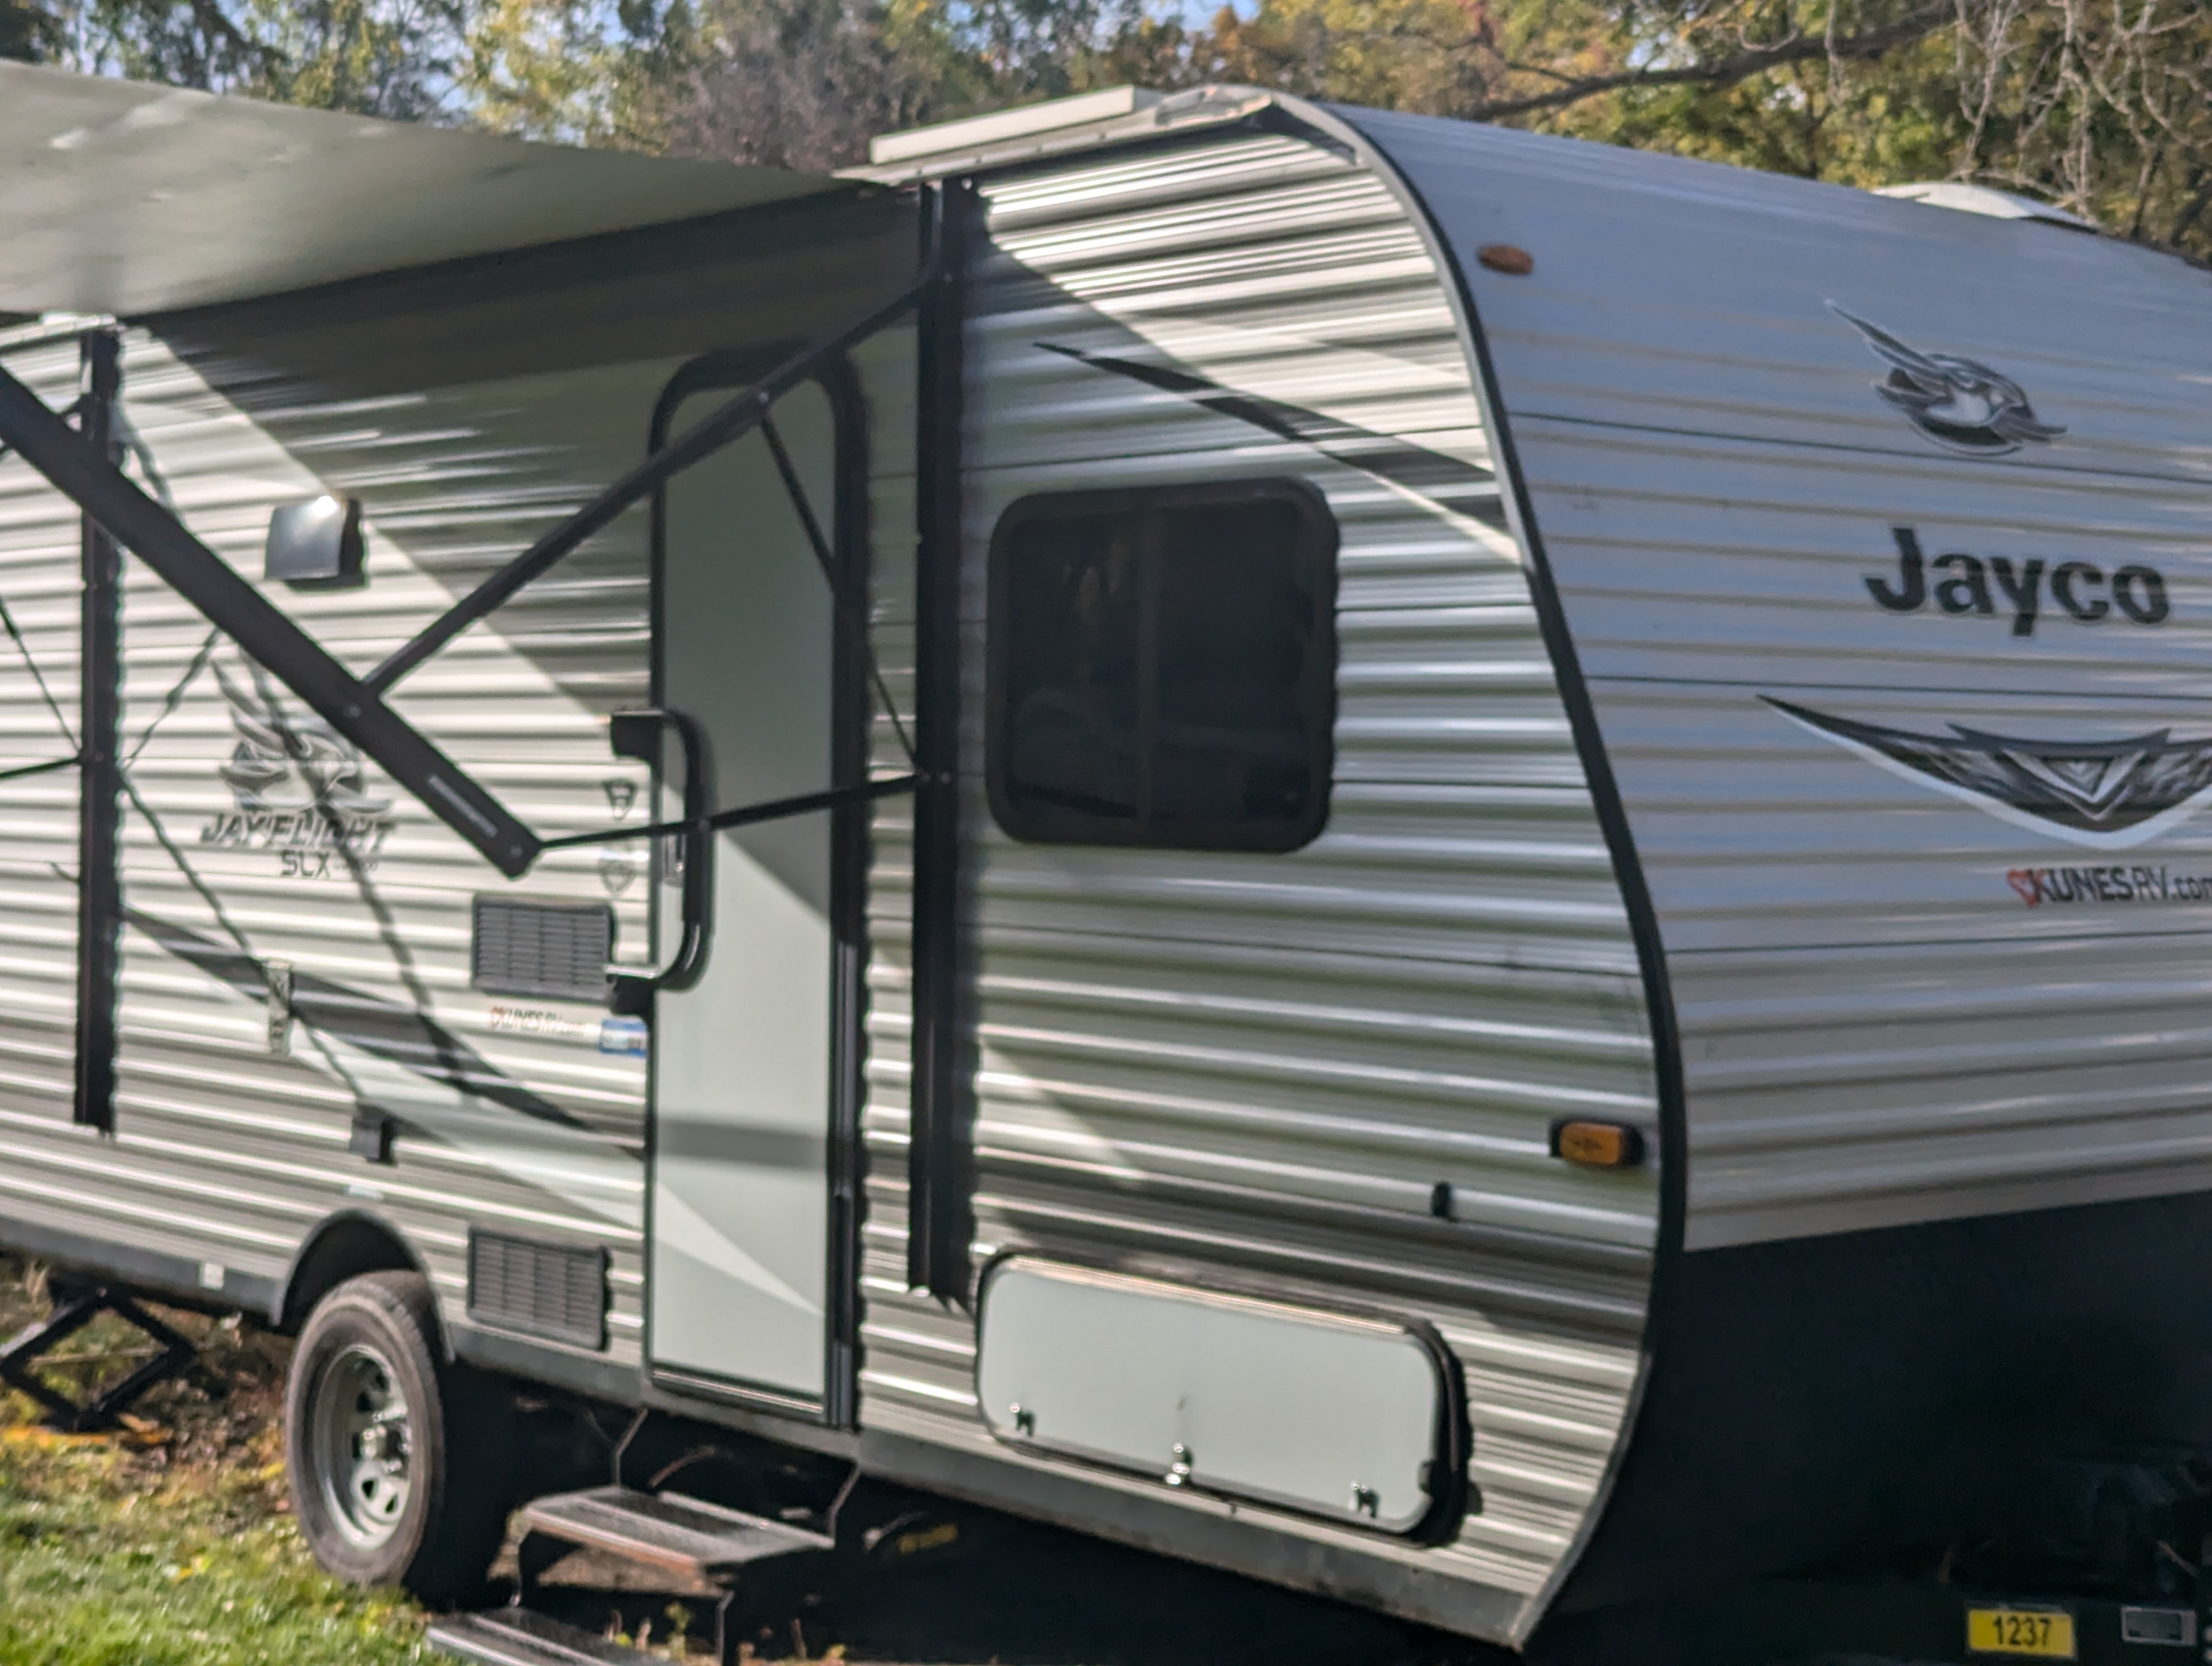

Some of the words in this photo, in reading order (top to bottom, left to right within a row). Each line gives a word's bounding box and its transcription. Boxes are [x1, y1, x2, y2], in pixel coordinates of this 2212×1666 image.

[1864, 525, 2170, 637] Jayco
[280, 849, 330, 878] SLX
[1992, 1615, 2052, 1647] 1237
